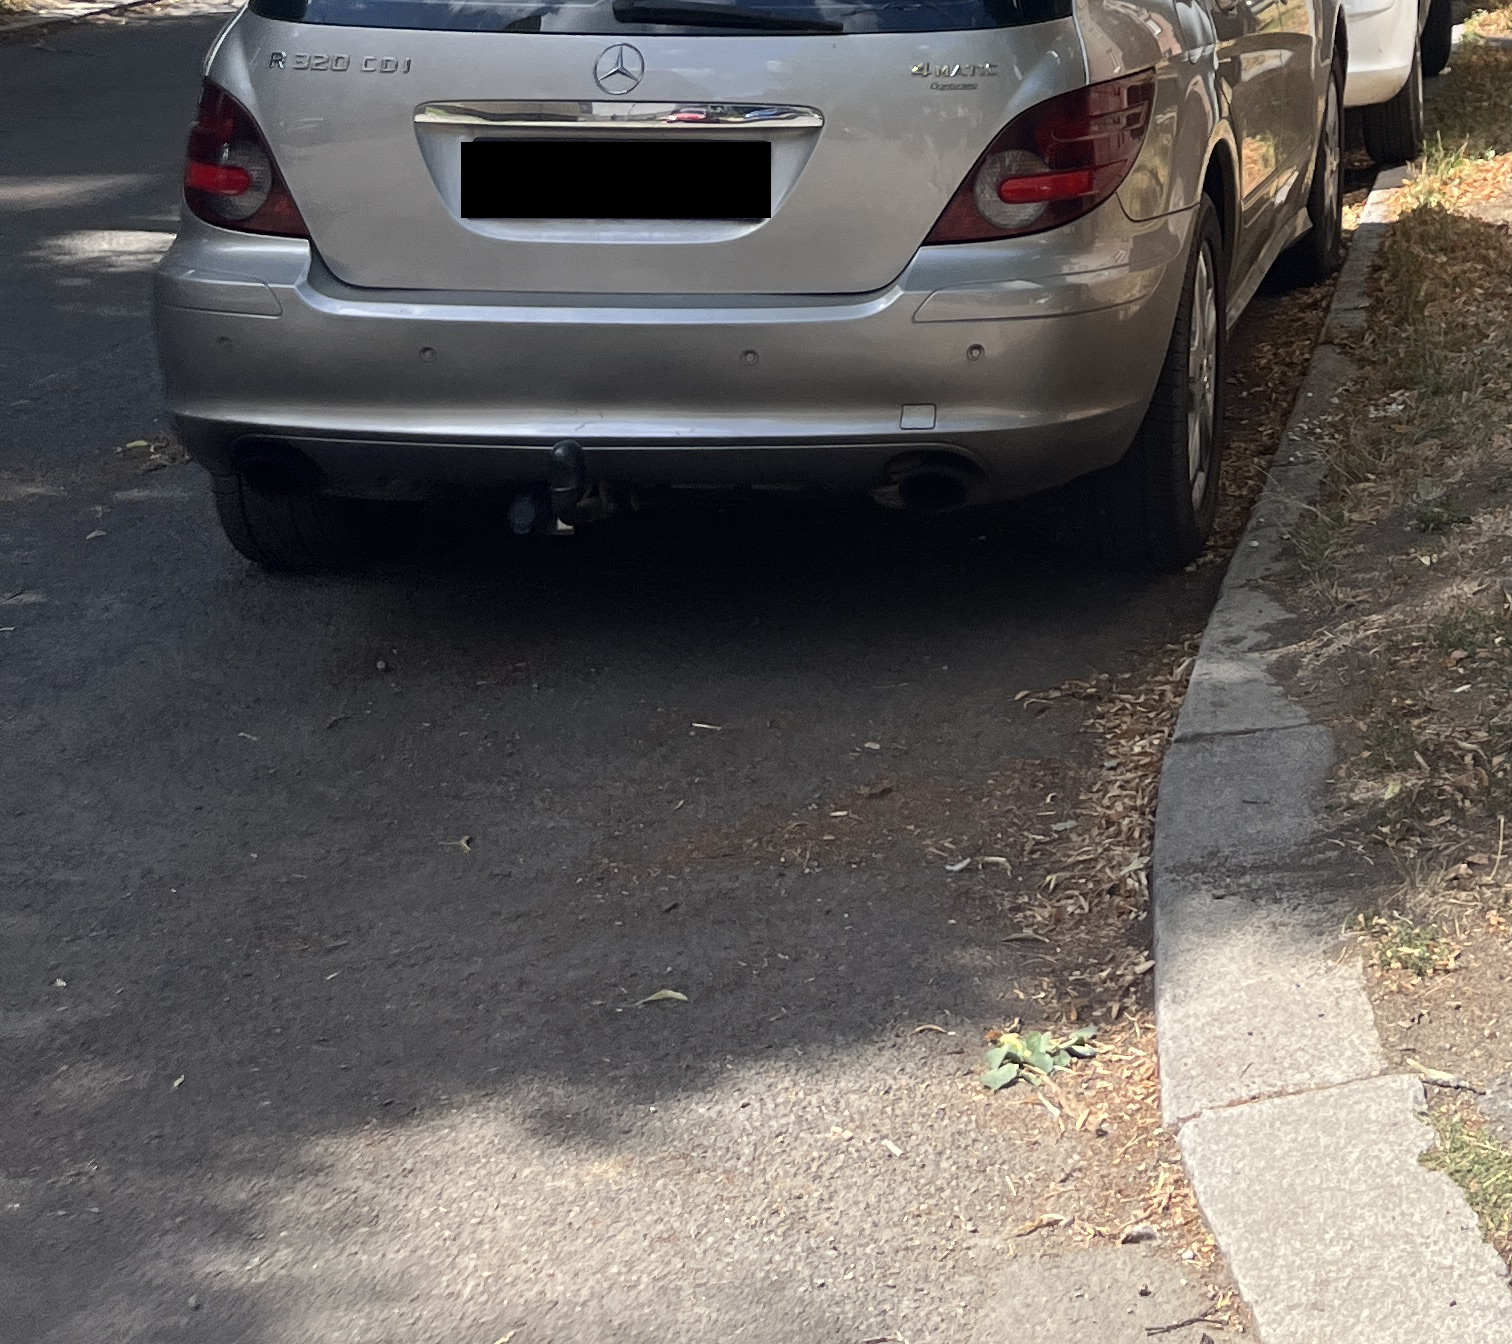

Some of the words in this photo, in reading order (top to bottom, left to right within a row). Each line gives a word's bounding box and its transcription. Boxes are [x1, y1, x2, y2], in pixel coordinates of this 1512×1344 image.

[269, 51, 287, 69] R
[293, 53, 350, 72] 320
[361, 55, 412, 74] CDI
